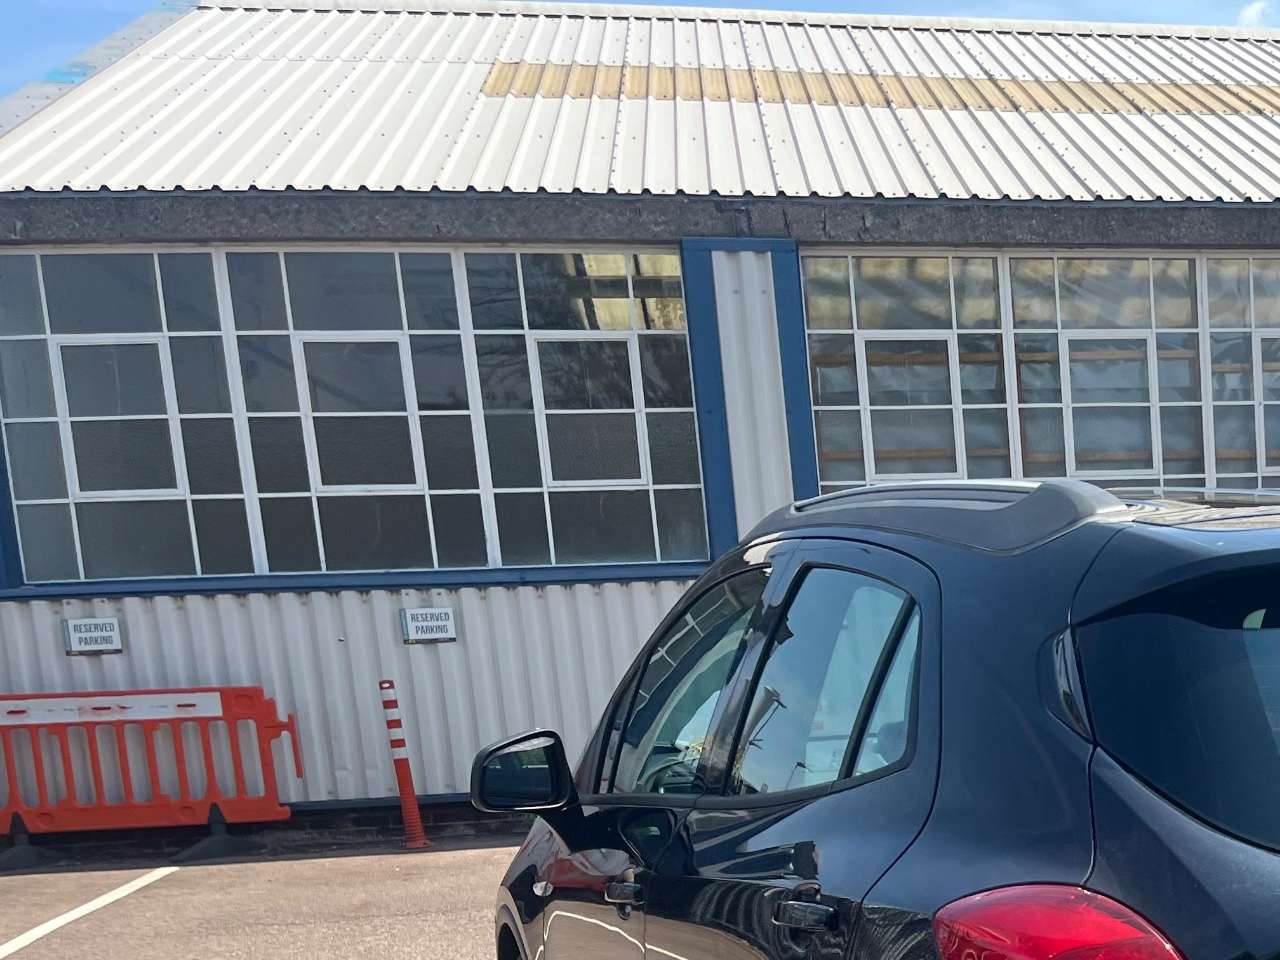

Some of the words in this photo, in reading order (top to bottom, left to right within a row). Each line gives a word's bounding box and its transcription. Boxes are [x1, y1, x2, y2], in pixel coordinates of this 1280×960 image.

[410, 612, 450, 622] RESERVED
[73, 622, 115, 633] RESERVED
[415, 624, 449, 634] PARKING
[79, 635, 113, 646] PARKING
